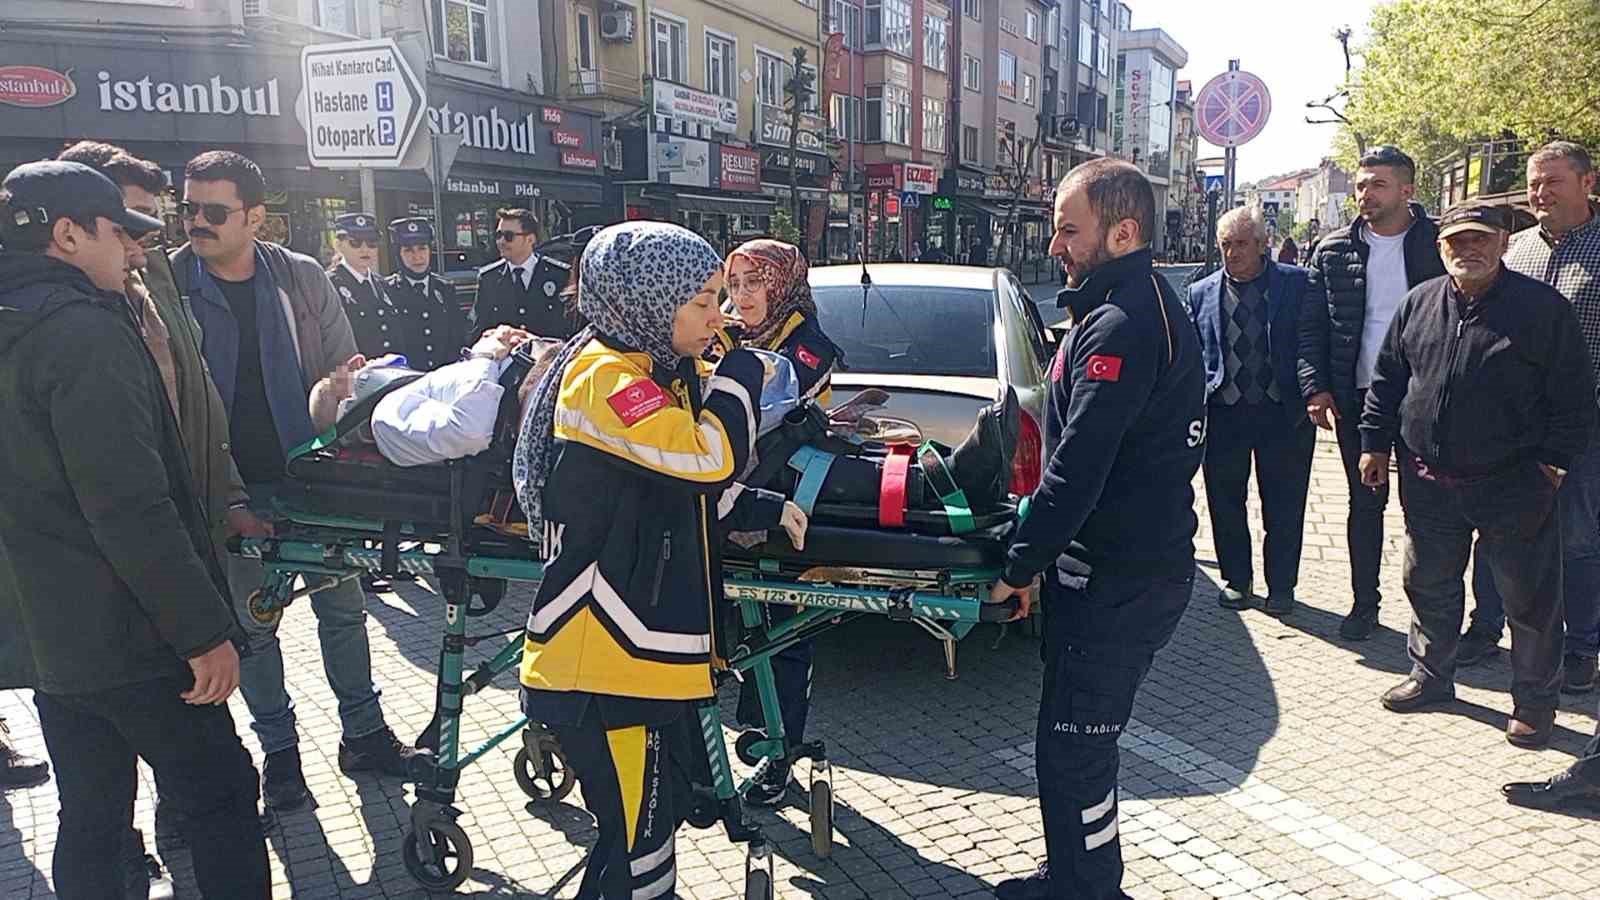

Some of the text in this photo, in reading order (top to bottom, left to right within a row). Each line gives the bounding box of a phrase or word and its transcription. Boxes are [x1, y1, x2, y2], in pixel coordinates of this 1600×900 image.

[312, 61, 335, 77] Nihat
[375, 56, 396, 73] Cad.
[0, 79, 60, 94] stanbul
[98, 70, 281, 117] istanbul
[314, 91, 369, 113] Hastane
[317, 123, 377, 152] Otopark
[426, 101, 536, 155] stanbul
[739, 587, 758, 599] ES
[763, 586, 786, 601] 125
